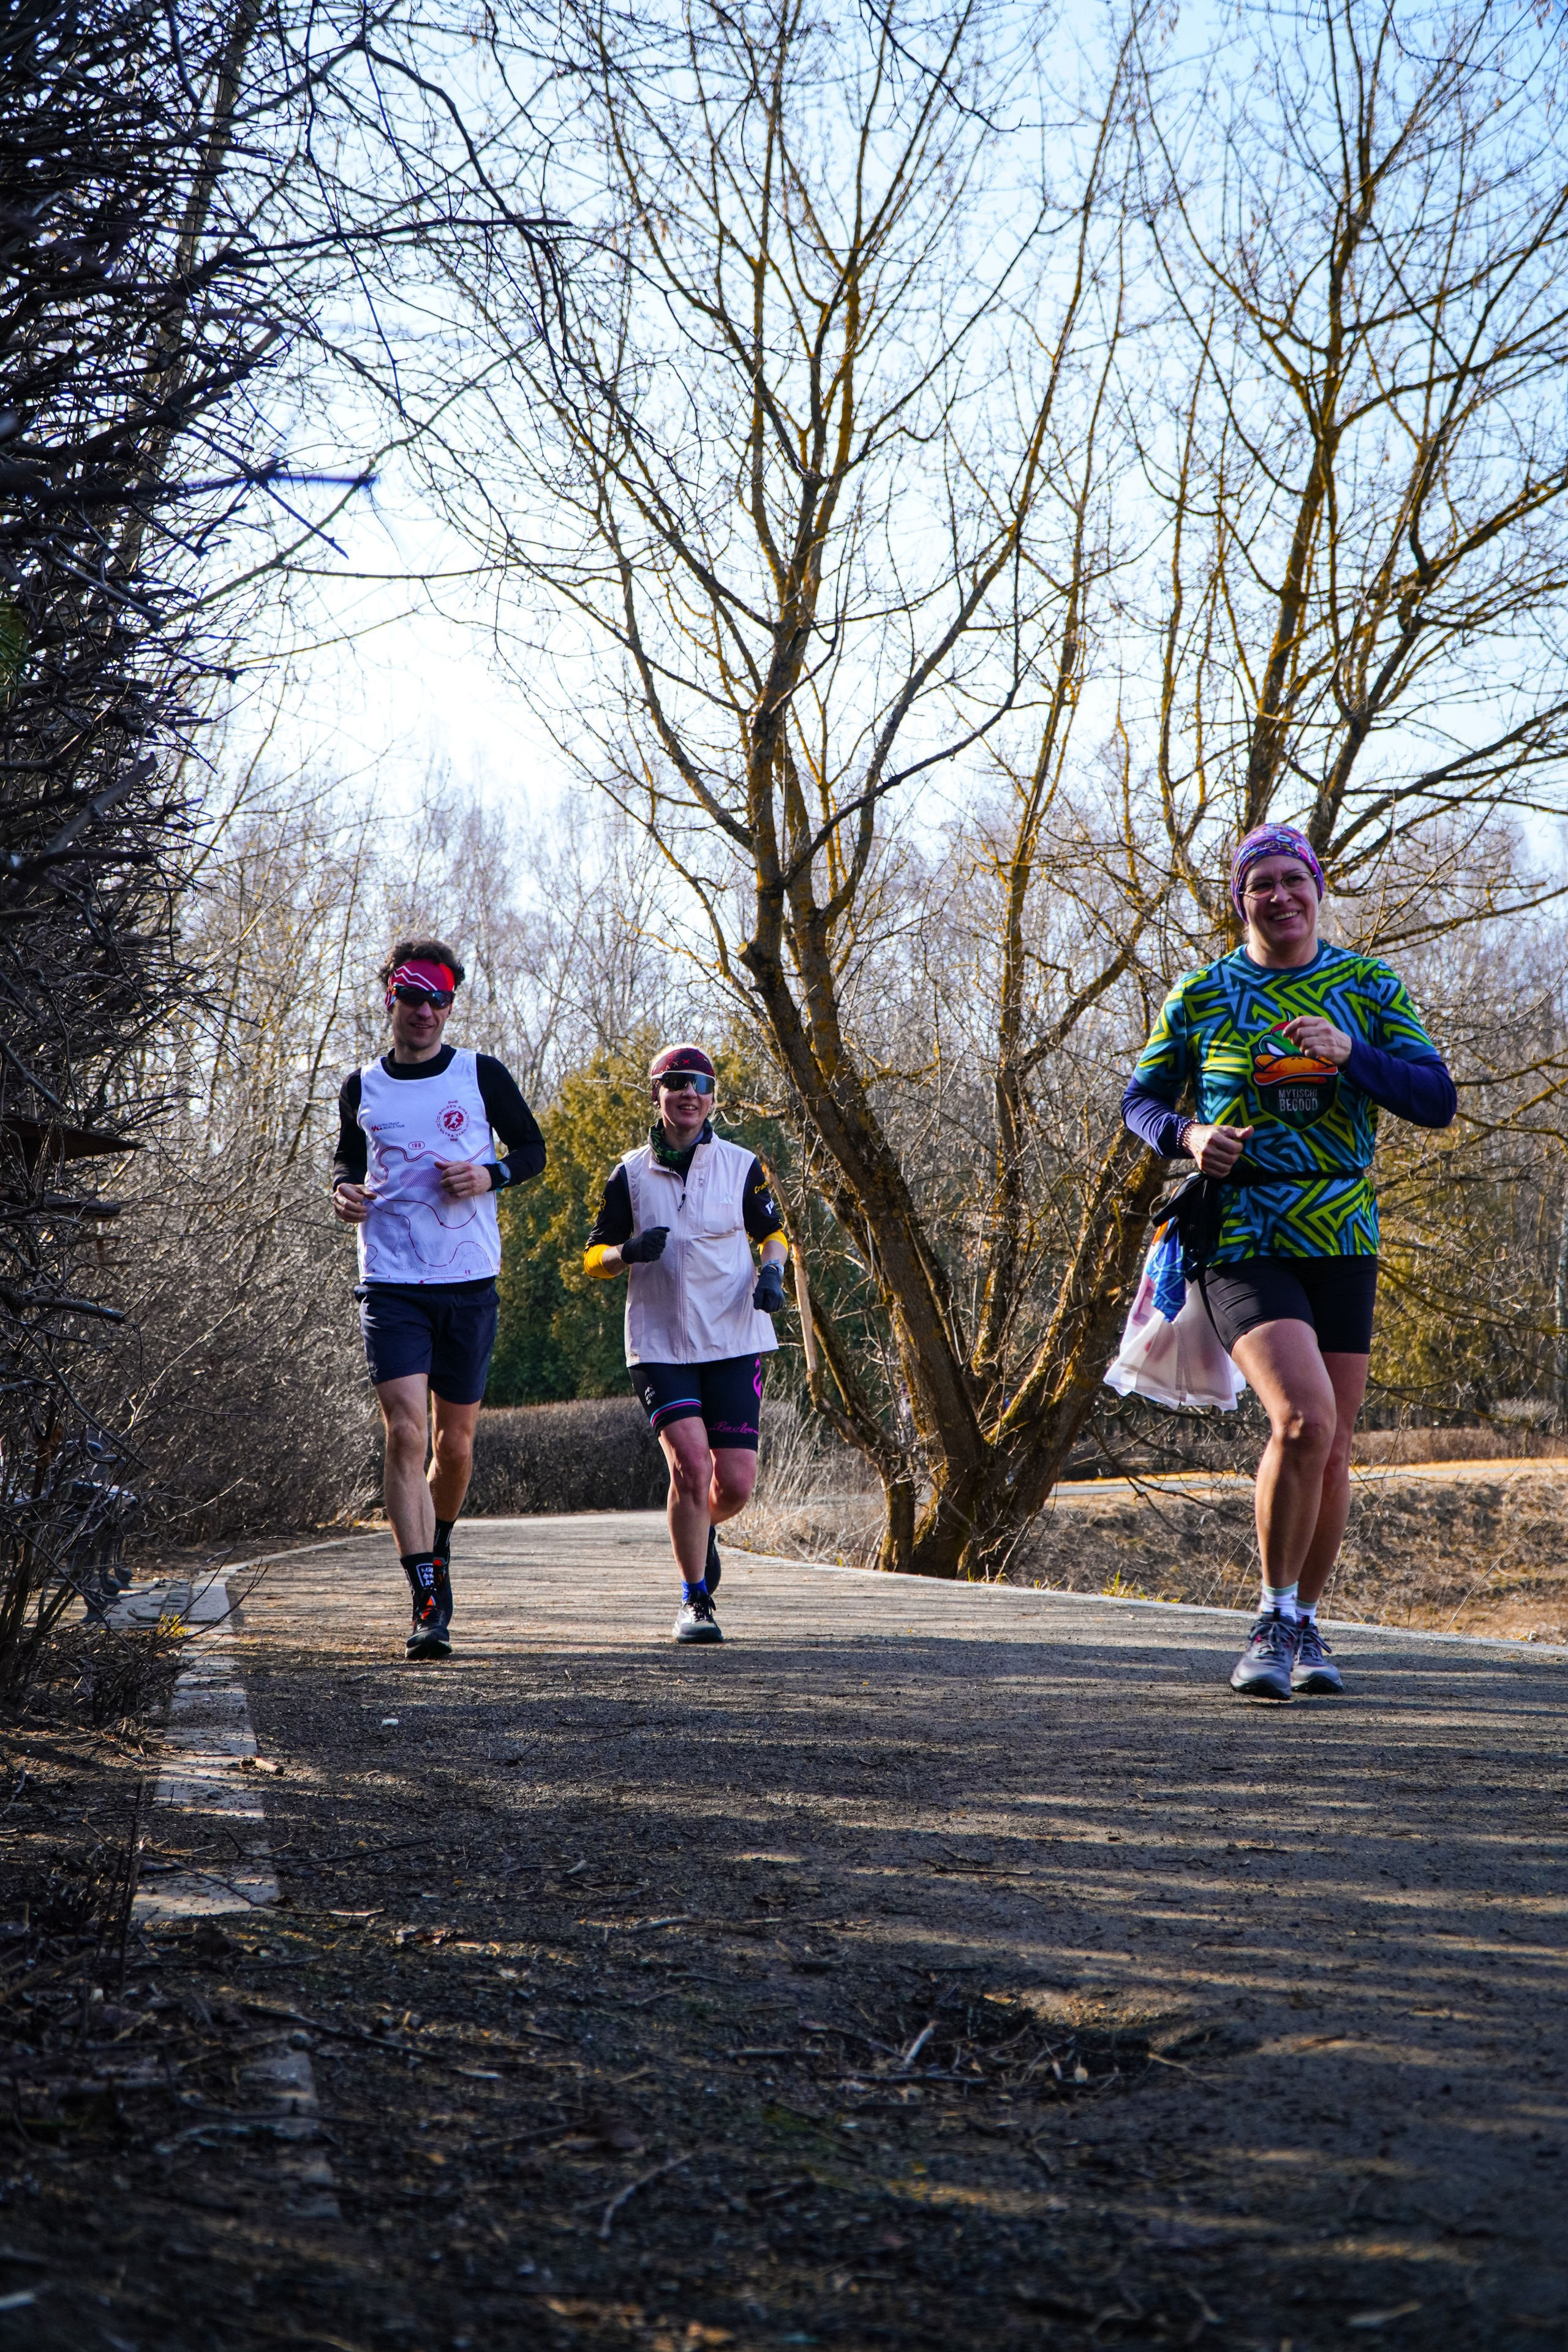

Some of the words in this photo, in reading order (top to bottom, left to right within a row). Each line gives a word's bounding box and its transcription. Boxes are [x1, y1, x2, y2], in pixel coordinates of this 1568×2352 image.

[1278, 1089, 1317, 1098] MYTISCHI
[1279, 1098, 1318, 1112] BEGOOD
[439, 1105, 456, 1115] GOLDEN
[458, 1106, 467, 1115] RING
[439, 1128, 454, 1137] ULTRA
